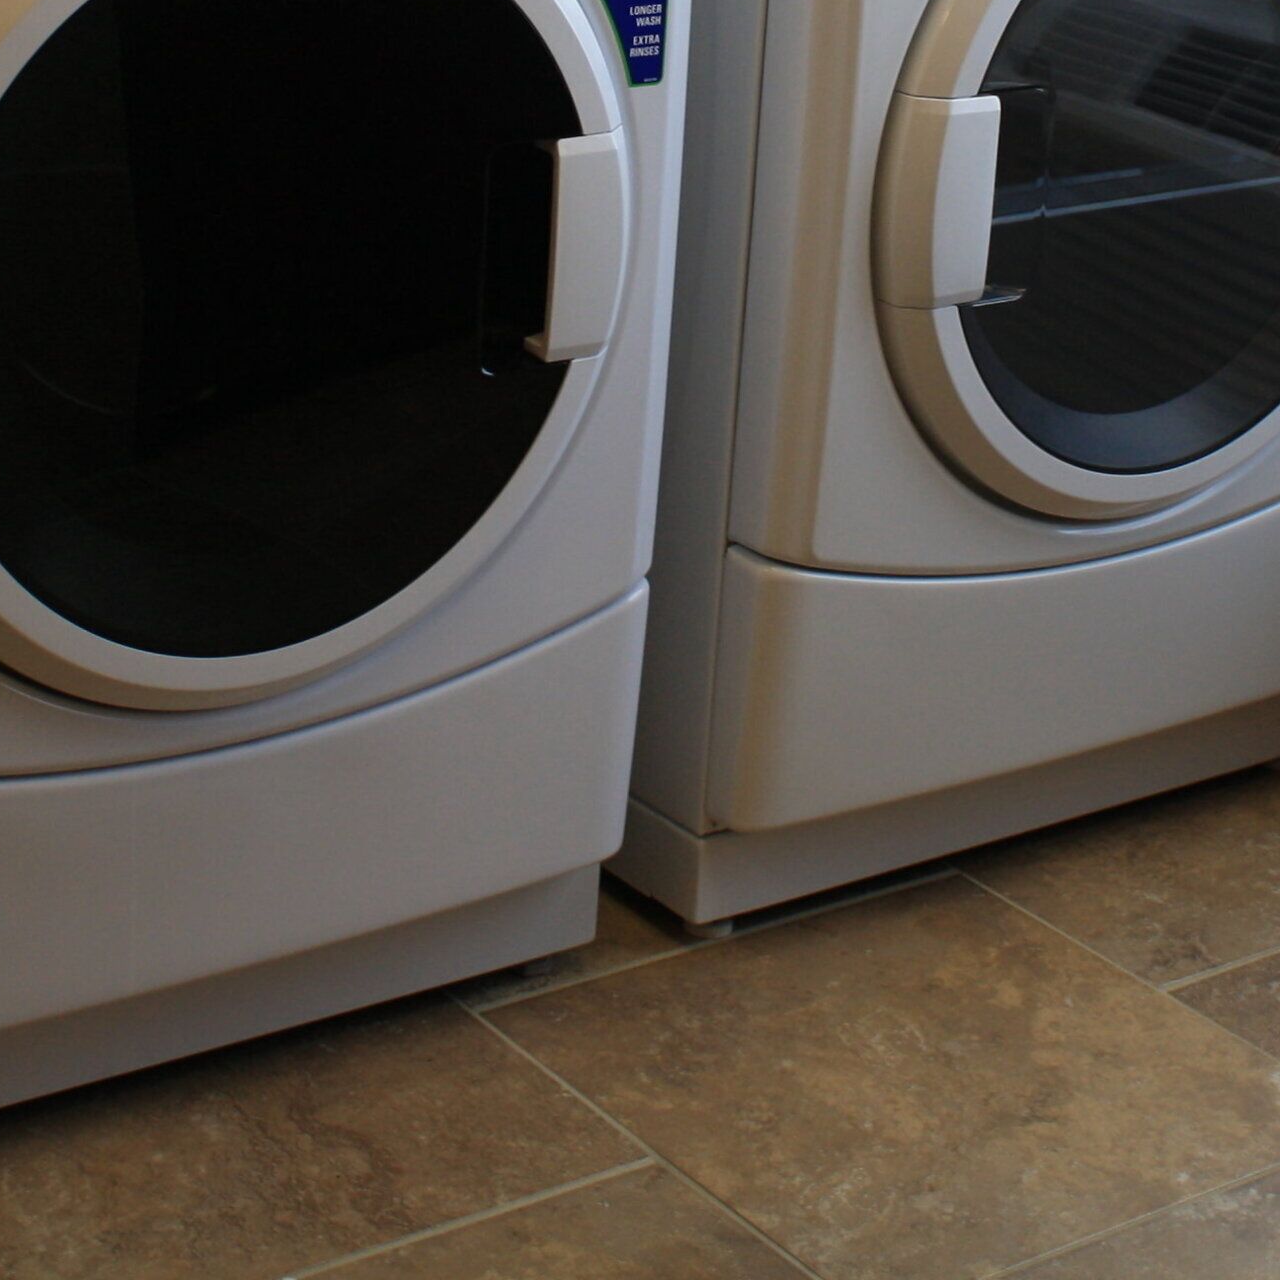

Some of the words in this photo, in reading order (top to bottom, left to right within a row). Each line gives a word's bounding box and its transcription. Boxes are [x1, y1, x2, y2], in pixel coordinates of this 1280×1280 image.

[629, 3, 662, 16] LONGER
[635, 15, 662, 27] WASH
[632, 33, 660, 46] EXTRA
[629, 45, 659, 58] RINSES
